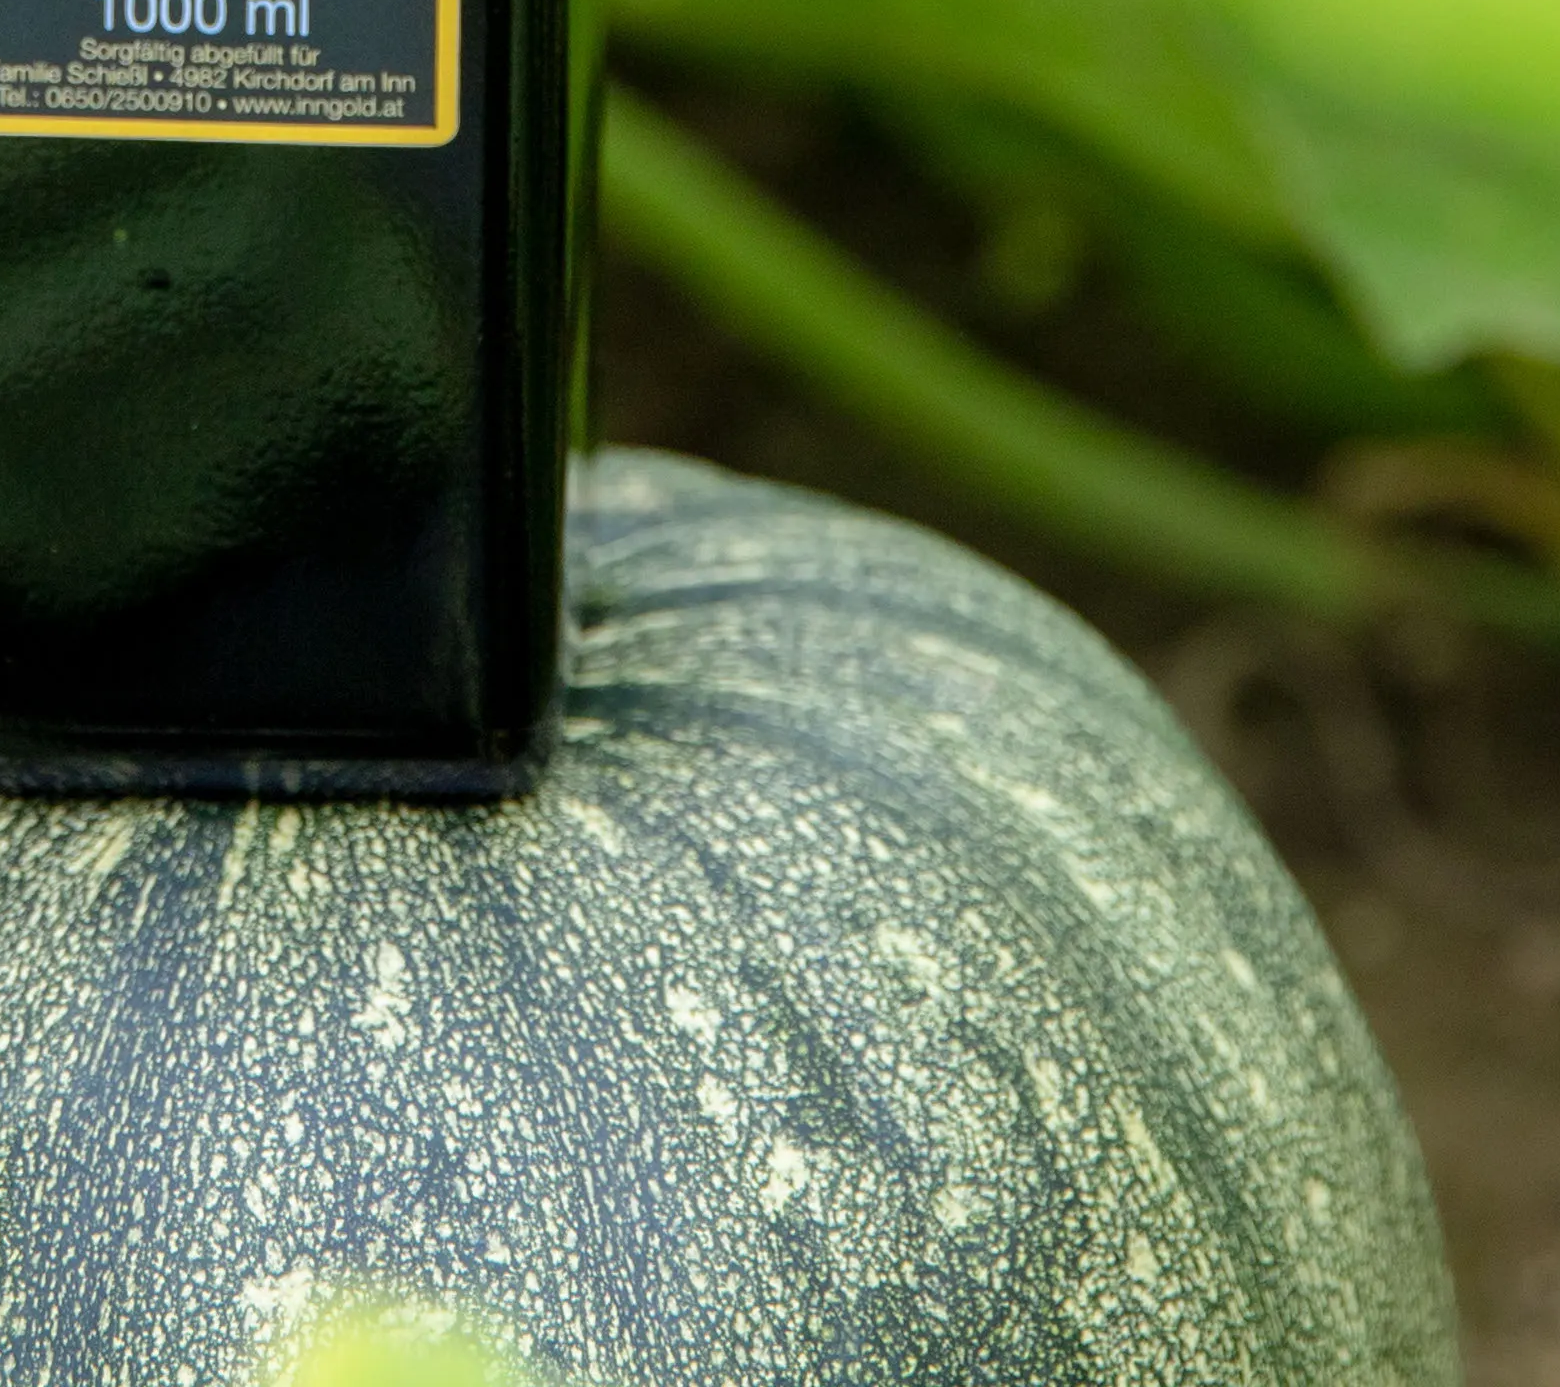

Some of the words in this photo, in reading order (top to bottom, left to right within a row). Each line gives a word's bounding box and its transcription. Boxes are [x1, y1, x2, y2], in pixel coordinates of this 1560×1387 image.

[80, 36, 185, 66] Sorgfältig
[190, 42, 284, 69] abgefüllt
[290, 44, 321, 67] für
[233, 68, 335, 93] Kirchdorf
[339, 73, 376, 93] am
[381, 71, 416, 93] Inn
[44, 85, 212, 114] 0650/2500910
[232, 94, 406, 121] www.inngold.at
